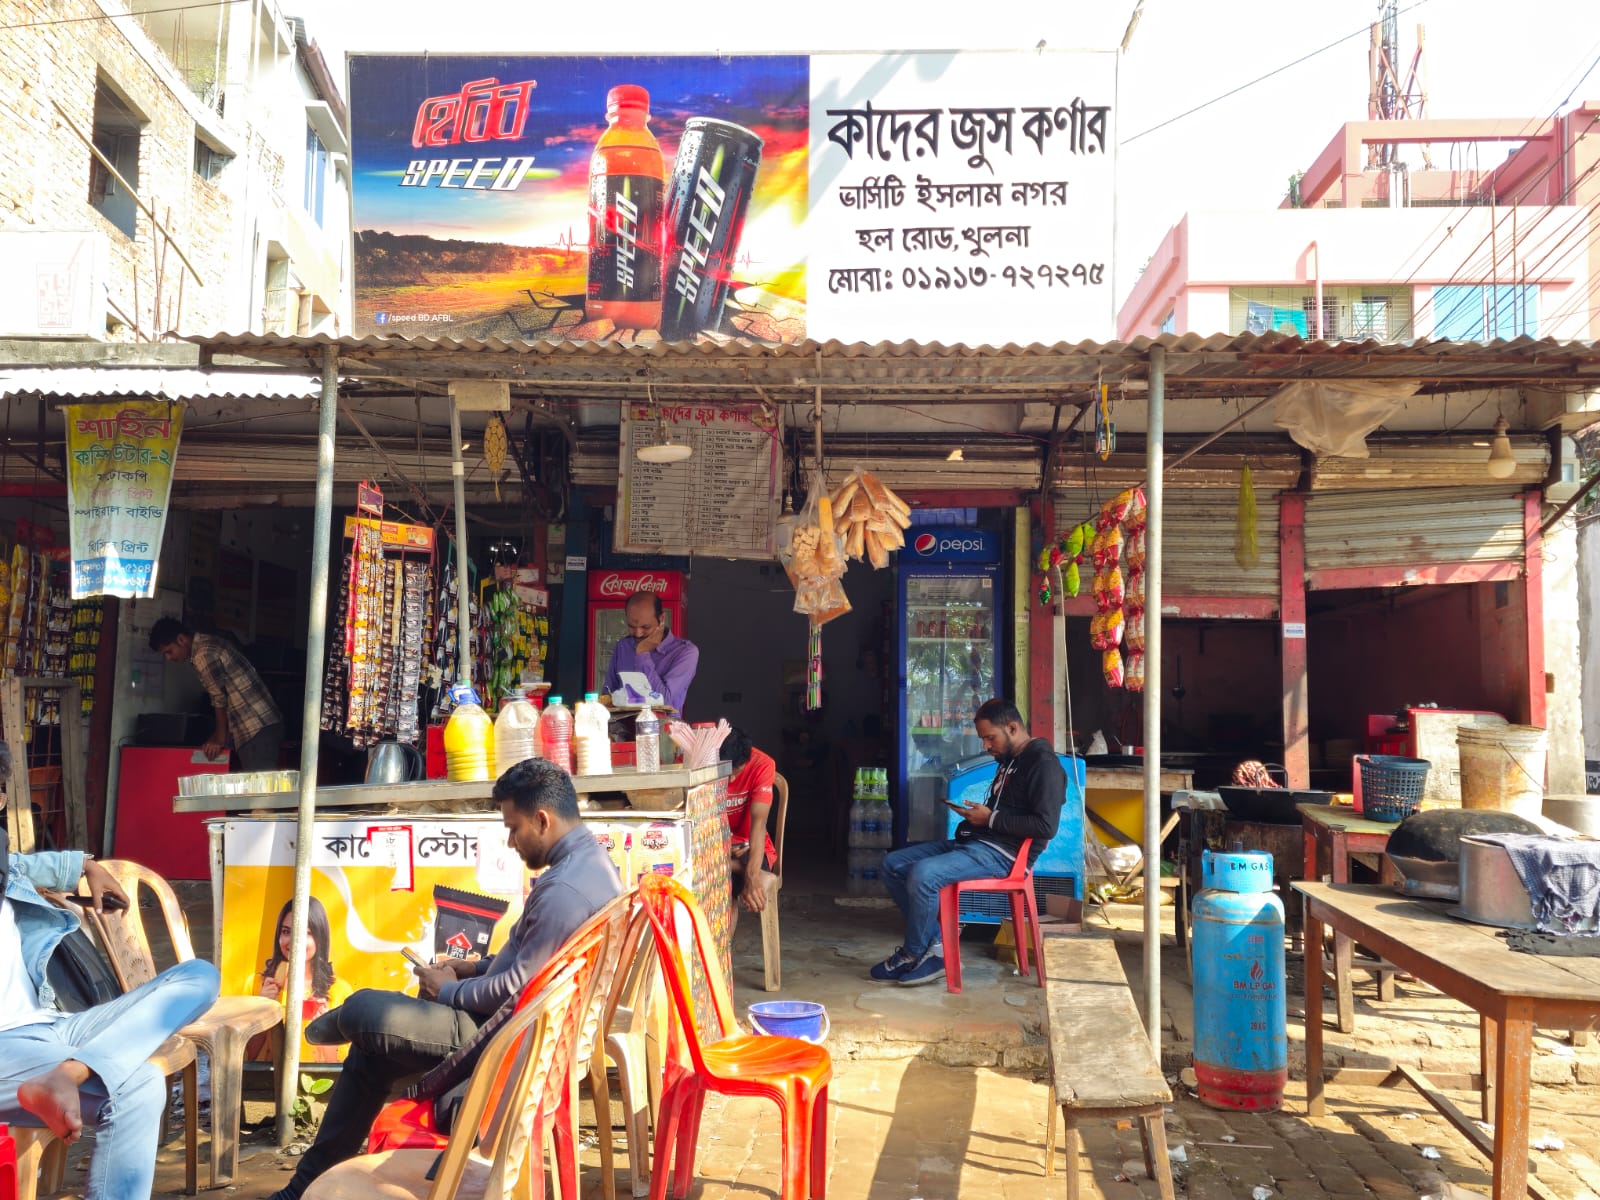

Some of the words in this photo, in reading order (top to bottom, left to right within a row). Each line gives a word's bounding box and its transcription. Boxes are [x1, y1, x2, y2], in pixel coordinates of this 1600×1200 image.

[826, 100, 944, 161] কাদের
[948, 107, 1016, 175] জুস
[1021, 96, 1112, 155] কর্ণার
[402, 157, 535, 190] SPEED
[839, 174, 906, 209] ভার্সিটি
[915, 174, 1004, 212] ইসলাম
[1011, 181, 1069, 207] নগর
[615, 191, 638, 289] SPEED
[675, 166, 726, 305] SPEED
[856, 228, 894, 252] হল
[902, 263, 1105, 290] ০১৯১৩-৭২৭২৭৫
[76, 409, 171, 439] শাহিন
[940, 538, 983, 553] pepsi
